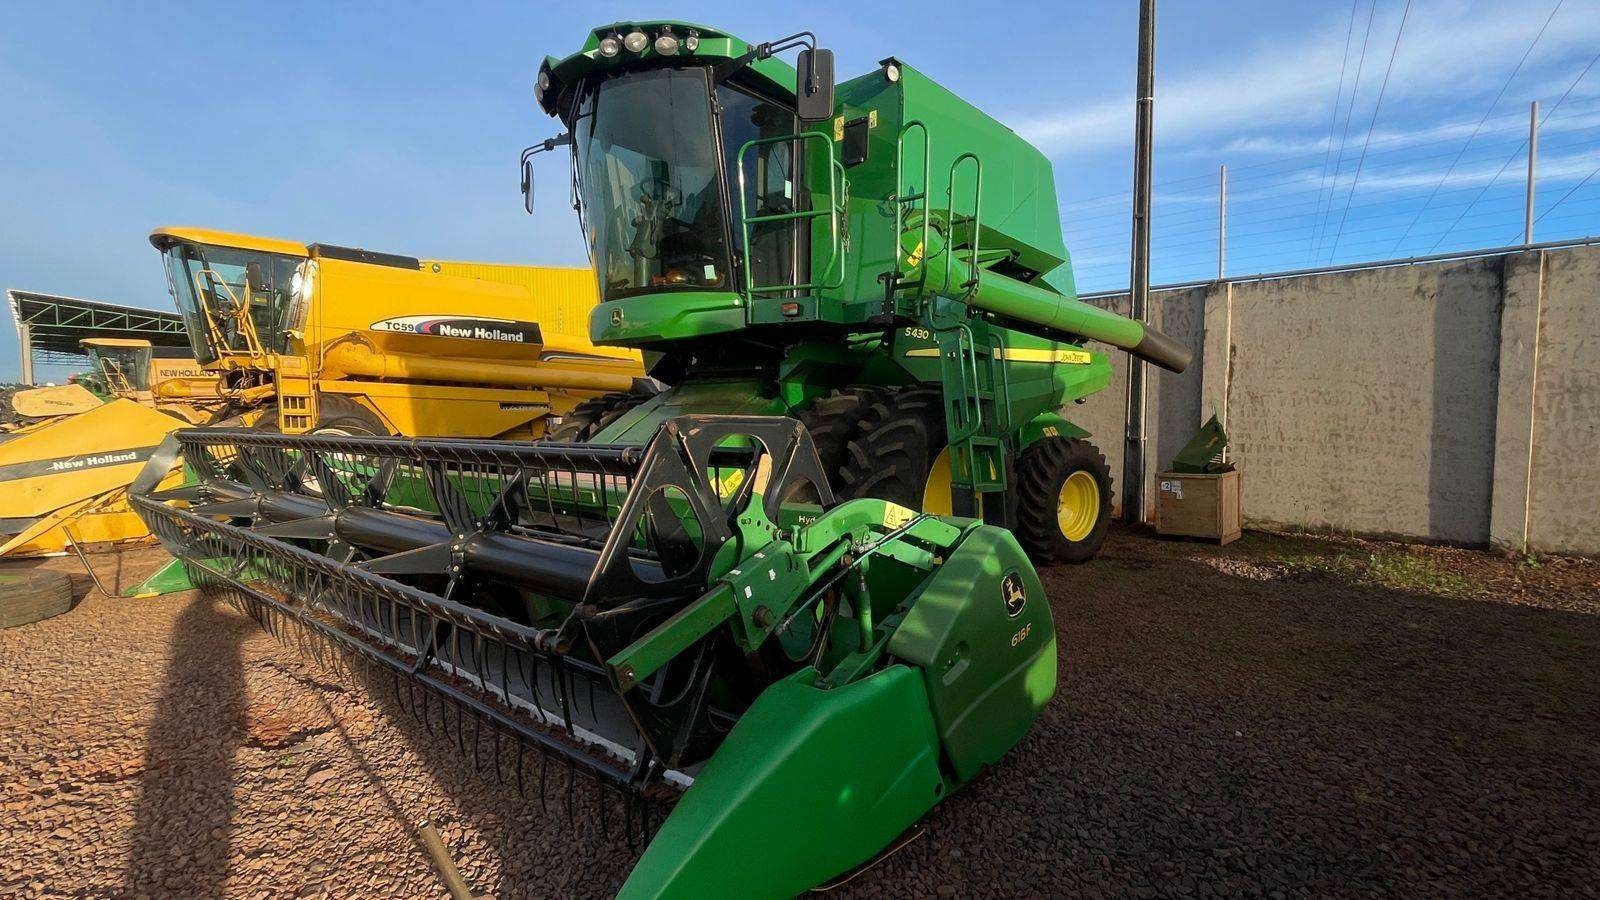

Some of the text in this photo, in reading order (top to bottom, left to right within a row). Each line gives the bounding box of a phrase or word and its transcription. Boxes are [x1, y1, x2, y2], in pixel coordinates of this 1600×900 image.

[385, 322, 414, 332] TC59
[439, 324, 523, 342] New Holland
[904, 327, 930, 340] S430
[53, 451, 137, 471] New Holland
